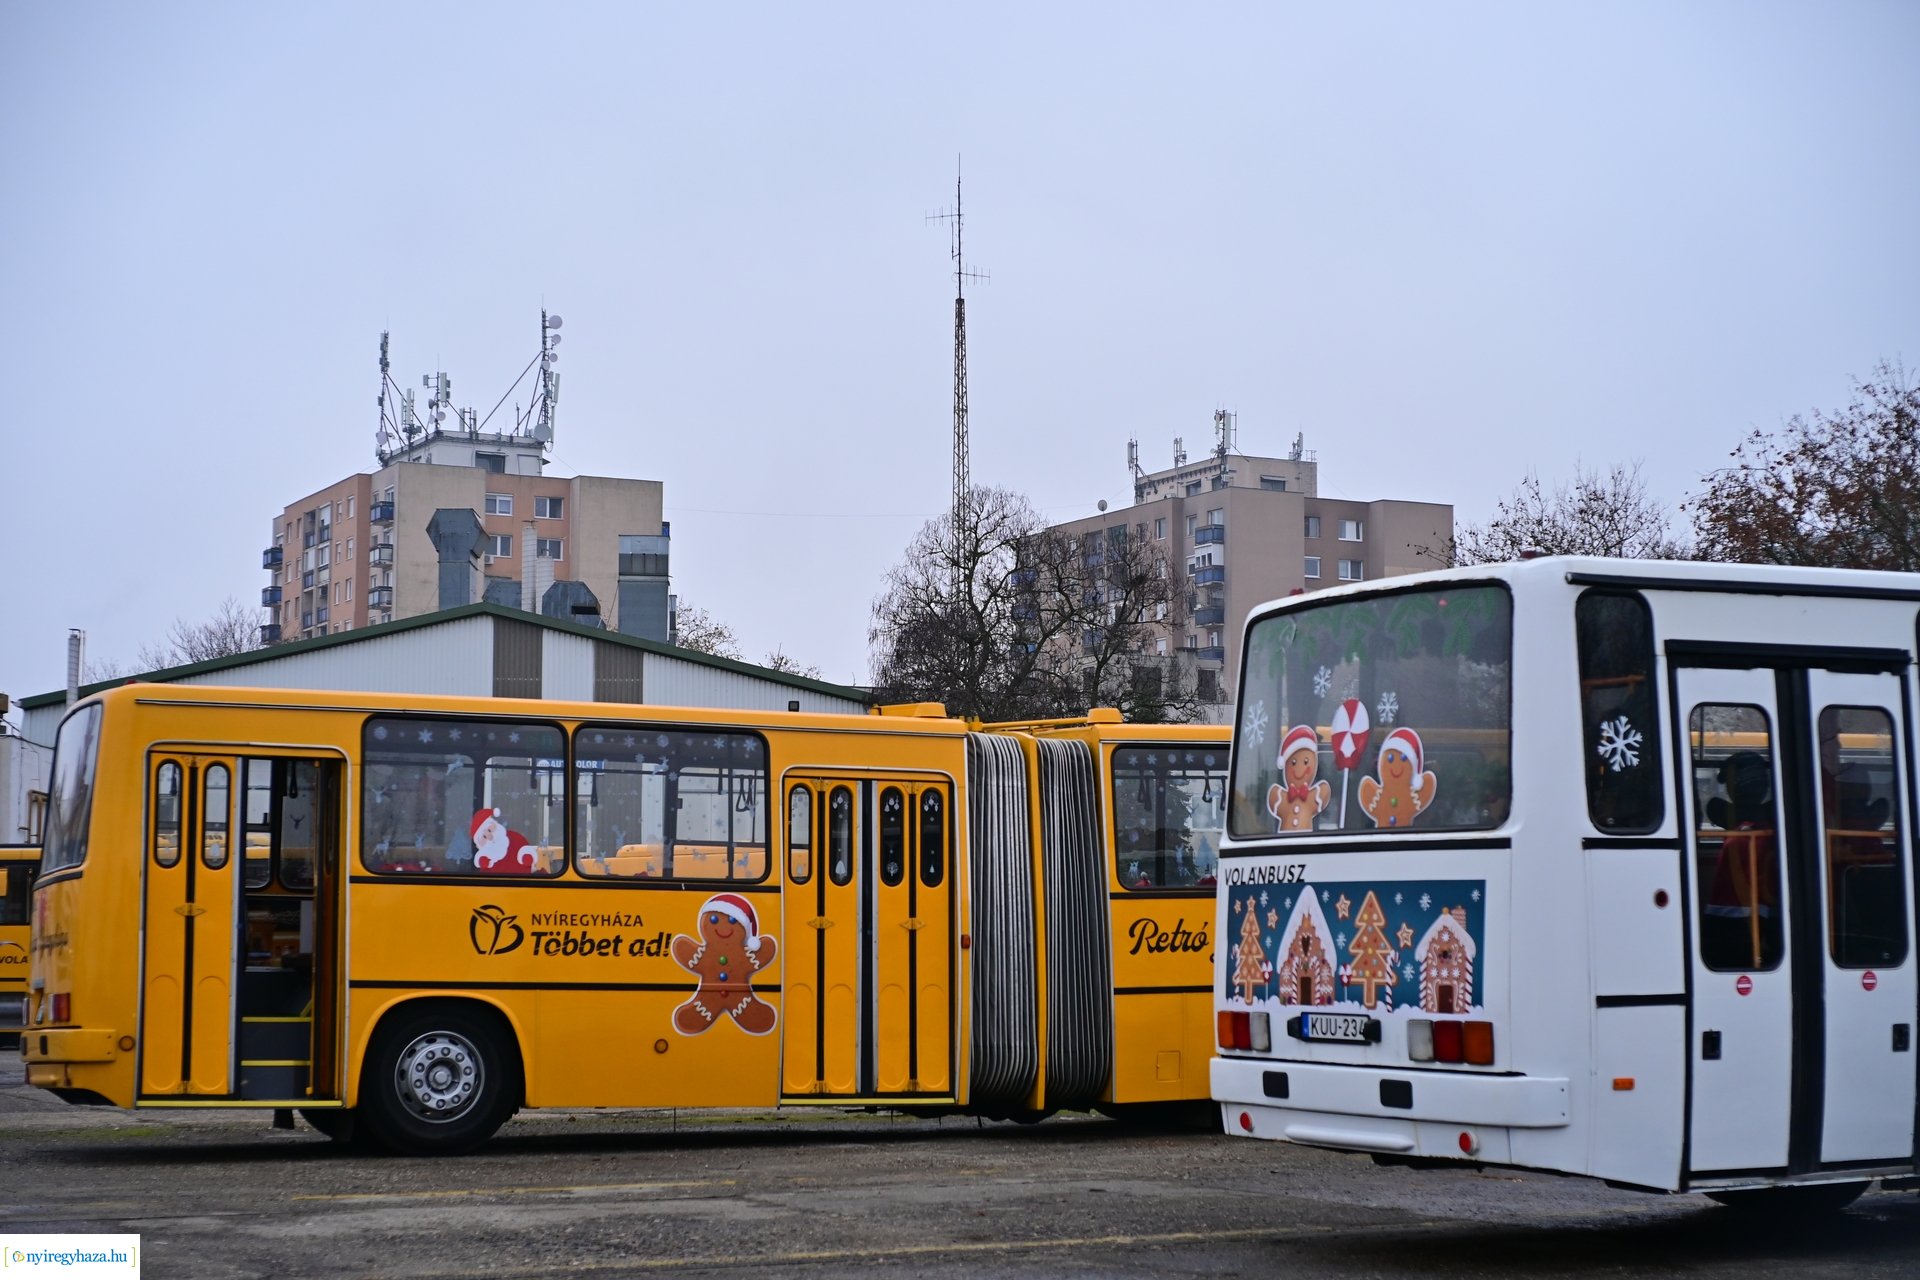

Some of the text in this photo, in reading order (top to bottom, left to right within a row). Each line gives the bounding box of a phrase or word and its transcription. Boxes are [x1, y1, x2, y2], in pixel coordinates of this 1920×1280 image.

[531, 911, 644, 927] NYÍREGYHÁZA
[531, 931, 672, 957] Többet ad!
[1128, 918, 1210, 955] Retró
